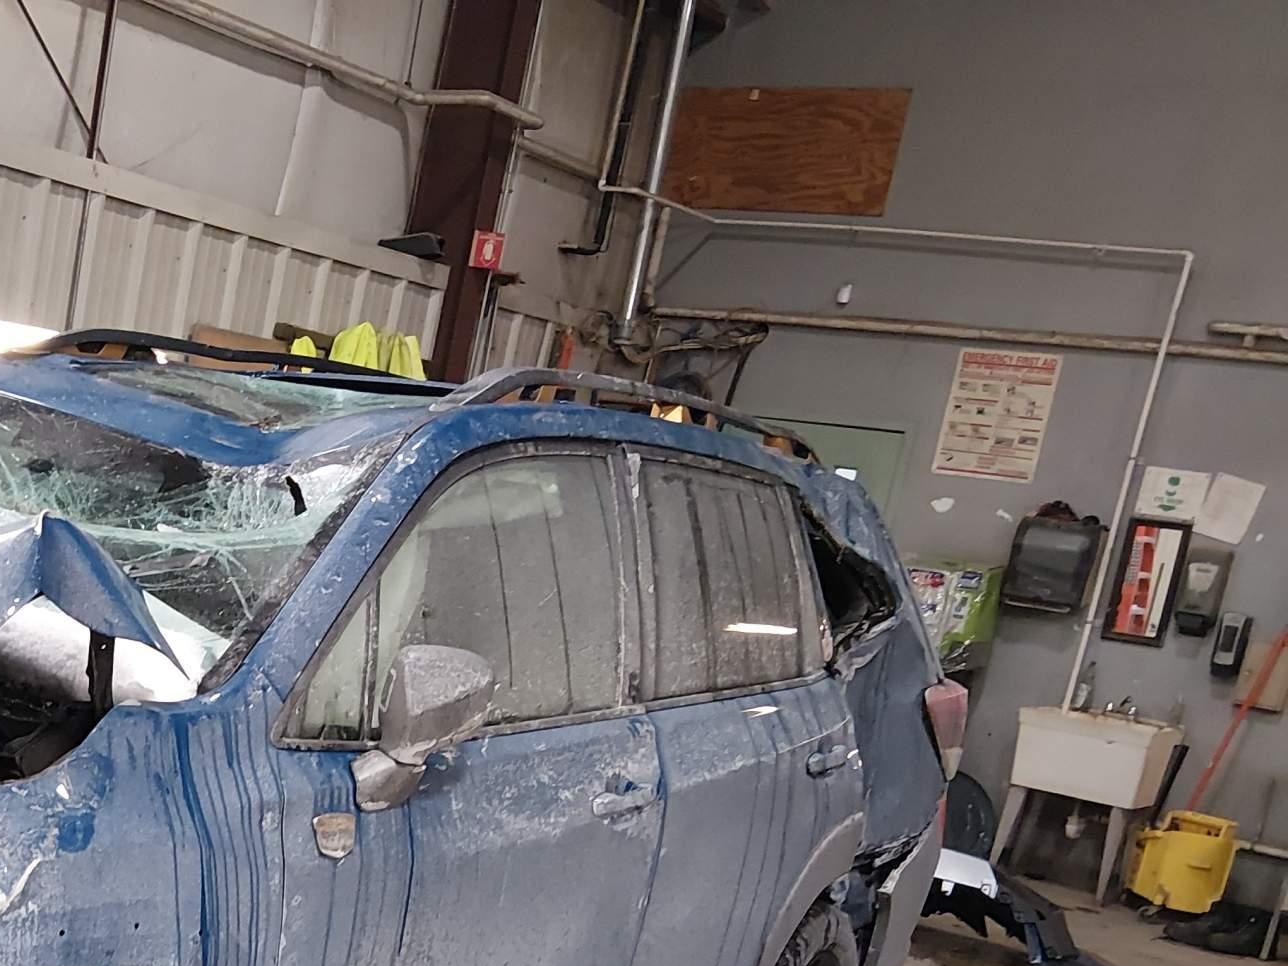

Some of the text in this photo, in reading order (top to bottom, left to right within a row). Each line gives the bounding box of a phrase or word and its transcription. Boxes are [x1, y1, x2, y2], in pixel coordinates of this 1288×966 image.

[963, 352, 1058, 369] EMERGENCY FIRST AID
